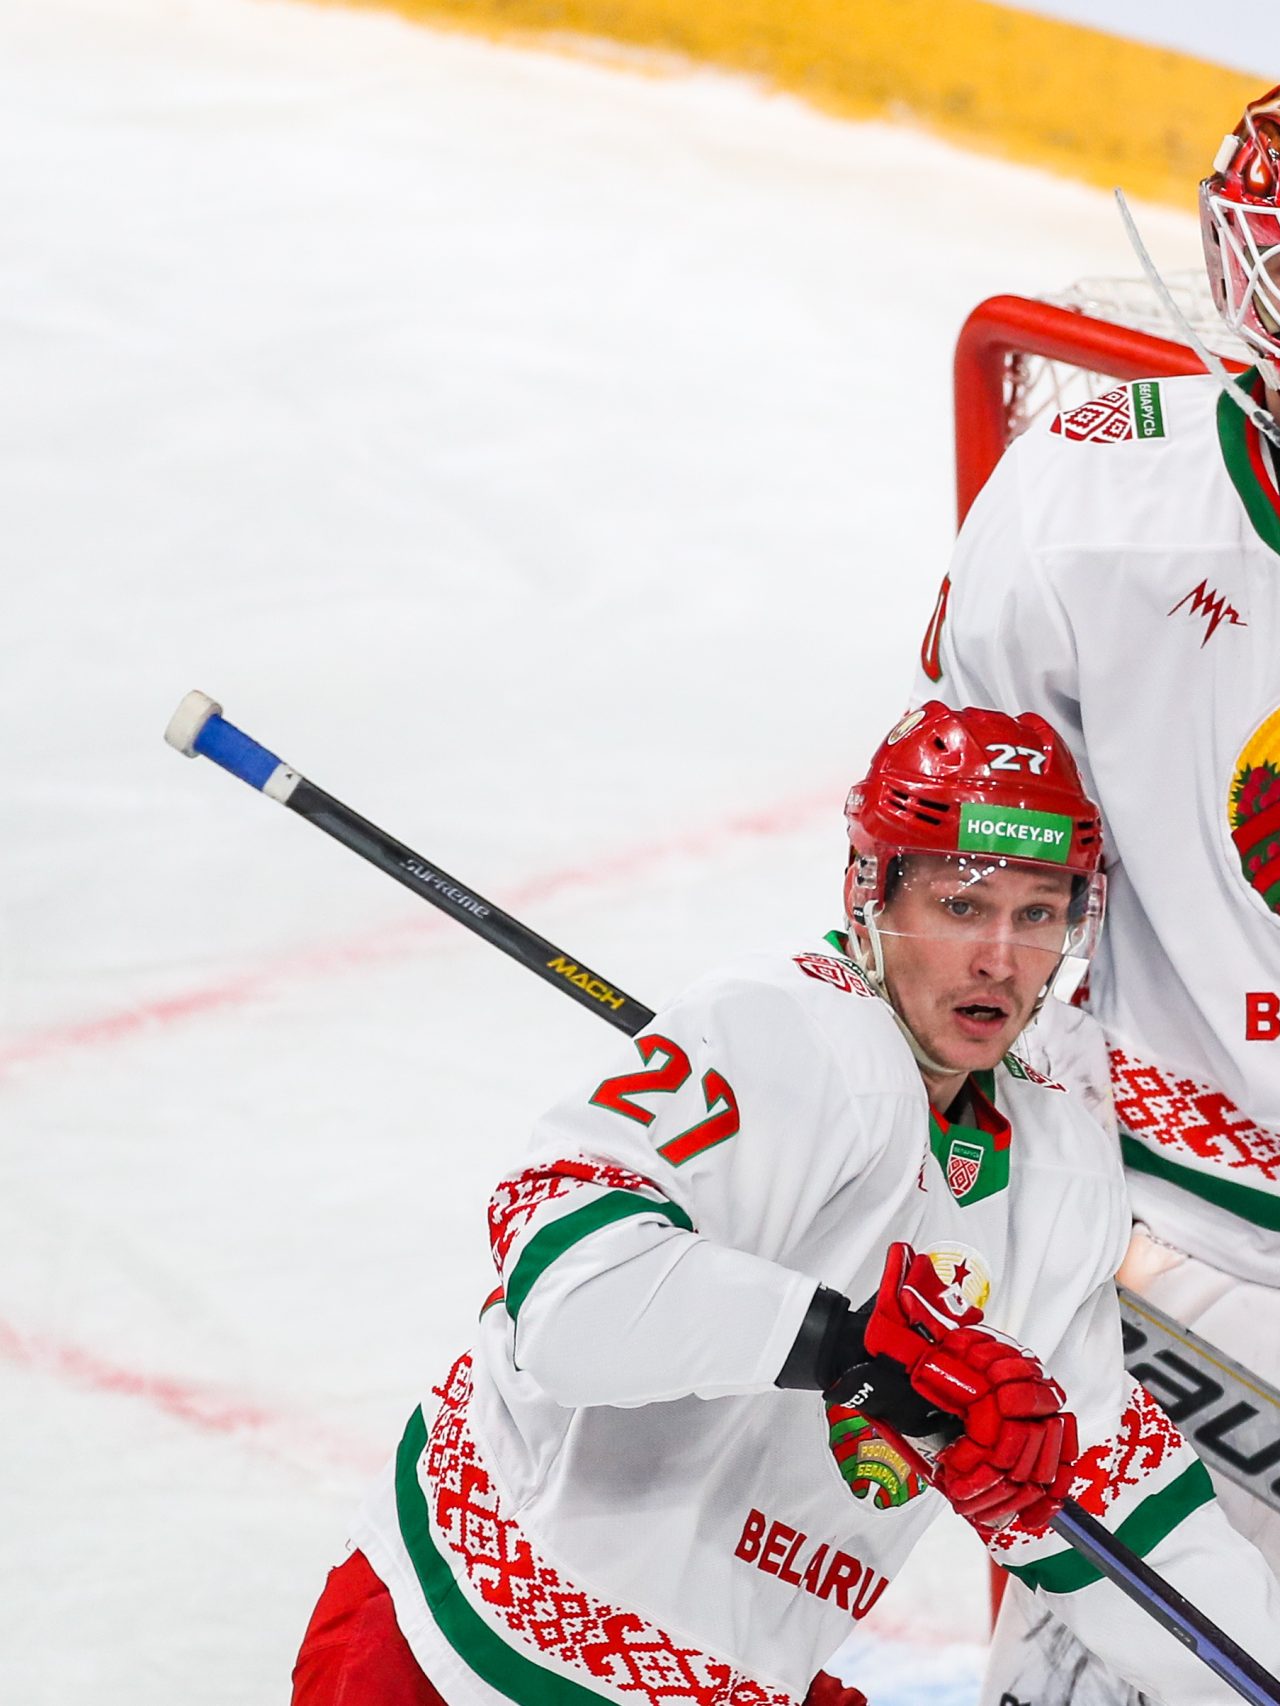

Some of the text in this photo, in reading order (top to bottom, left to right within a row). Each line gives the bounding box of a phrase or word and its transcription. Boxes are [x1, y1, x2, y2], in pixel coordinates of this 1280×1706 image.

[984, 743, 1047, 776] 27
[966, 819, 1065, 845] HOCKEY.BY
[547, 957, 625, 1012] MACH
[588, 1033, 740, 1168] 27
[734, 1508, 890, 1621] BELARU
